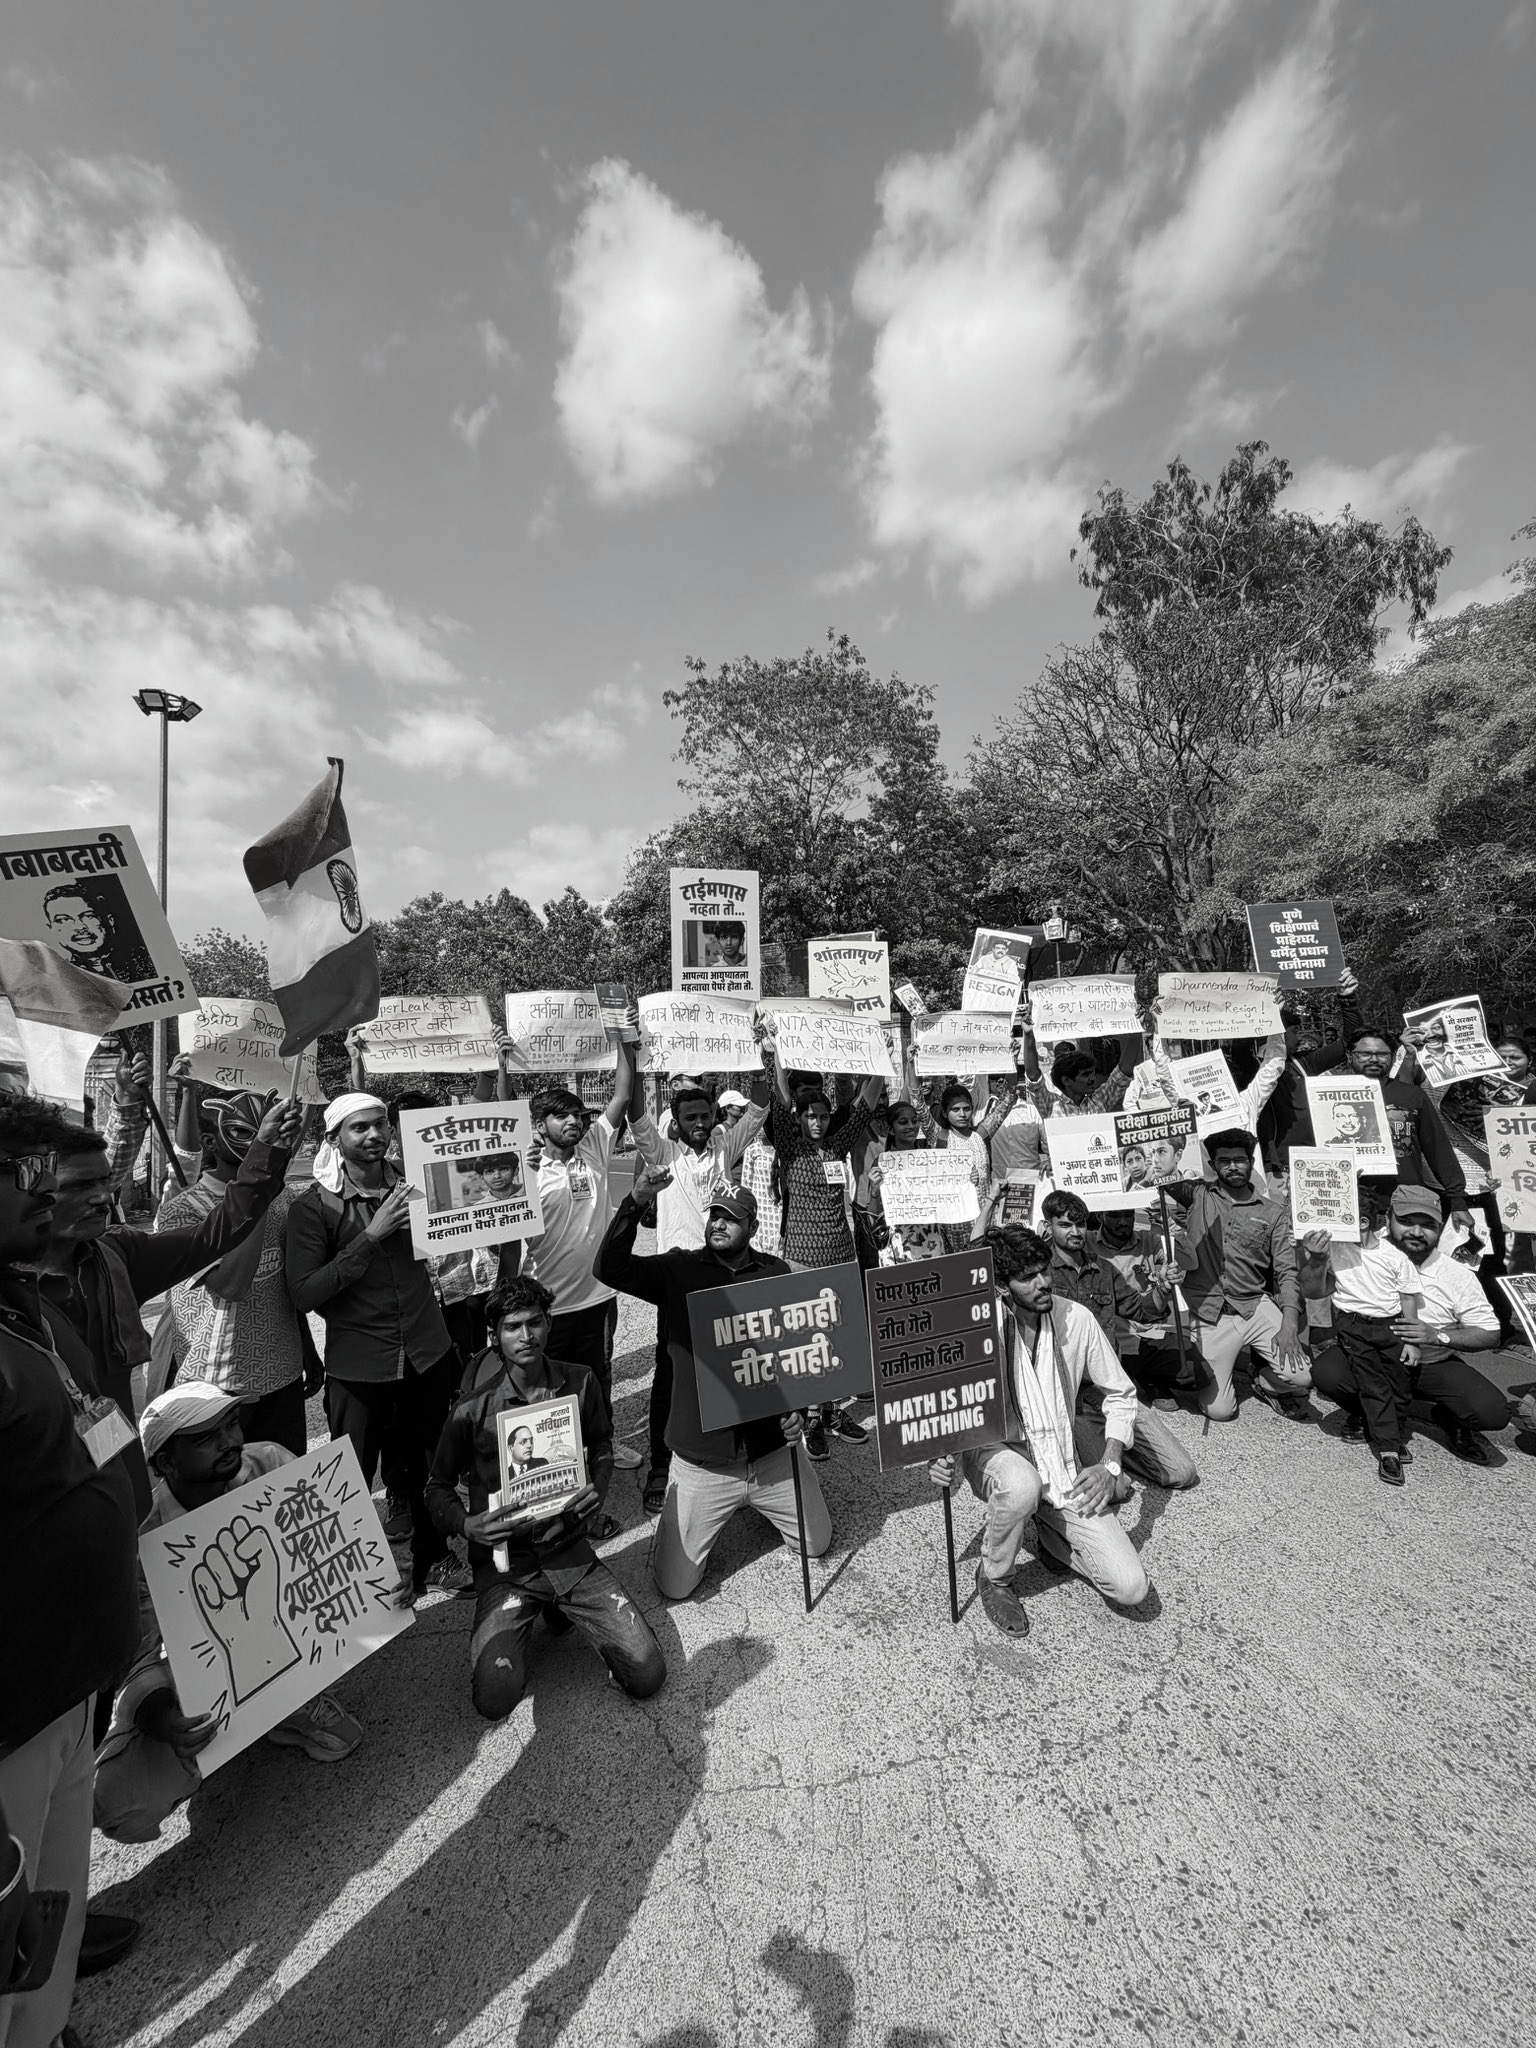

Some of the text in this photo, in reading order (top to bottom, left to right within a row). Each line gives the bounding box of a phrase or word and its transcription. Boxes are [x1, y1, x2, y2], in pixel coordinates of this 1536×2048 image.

[679, 877, 748, 902] टाईमपास
[689, 902, 720, 916] नव्हता
[1281, 908, 1303, 923] पुणे
[1269, 919, 1320, 934] शिक्षणाचं
[1275, 933, 1319, 946] माहेरघर,
[813, 947, 885, 965] शांततापूर्ण
[1298, 945, 1329, 956] प्रधान
[1277, 957, 1326, 970] राजीनामा
[682, 971, 749, 982] आपल्या आयुष्यातला
[712, 980, 726, 991] पेपर
[728, 980, 742, 991] होता
[1170, 977, 1239, 994] Dharmendra
[968, 979, 1016, 998] RESIGN
[645, 1008, 667, 1022] छात्र
[671, 1002, 700, 1023] विरोधी
[1184, 1000, 1211, 1014] Must
[371, 1017, 423, 1039] सरकार
[237, 1038, 276, 1059] प्रधान
[1316, 1086, 1375, 1101] जबाबदारी
[416, 1116, 519, 1143] टाईमपास
[1116, 1114, 1149, 1130] परीक्षा
[1120, 1121, 1192, 1145] सरकारचं उत्तर
[433, 1139, 480, 1156] नव्हता
[1088, 1158, 1102, 1167] हम
[1062, 1175, 1073, 1186] तो
[1074, 1171, 1099, 1185] गंदगी
[1306, 1167, 1324, 1178] देशात
[1318, 1188, 1331, 1198] पेपर
[428, 1200, 529, 1228] आपल्या आयुष्यातला
[475, 1217, 496, 1231] पेपर
[499, 1211, 520, 1227] होता
[875, 1267, 988, 1304] पेपर फुटले 79
[714, 1288, 837, 1347] NEET, काही
[877, 1303, 990, 1341] जीव गेले 08
[731, 1332, 840, 1386] नीट नाही.
[880, 1338, 993, 1378] राजीनामे दिले 0
[884, 1379, 996, 1425] MATH IS NOT
[535, 1415, 571, 1434] संविधान
[901, 1406, 985, 1445] MATHING
[281, 1511, 346, 1572] प्रधान
[284, 1537, 369, 1621] राजीनामा
